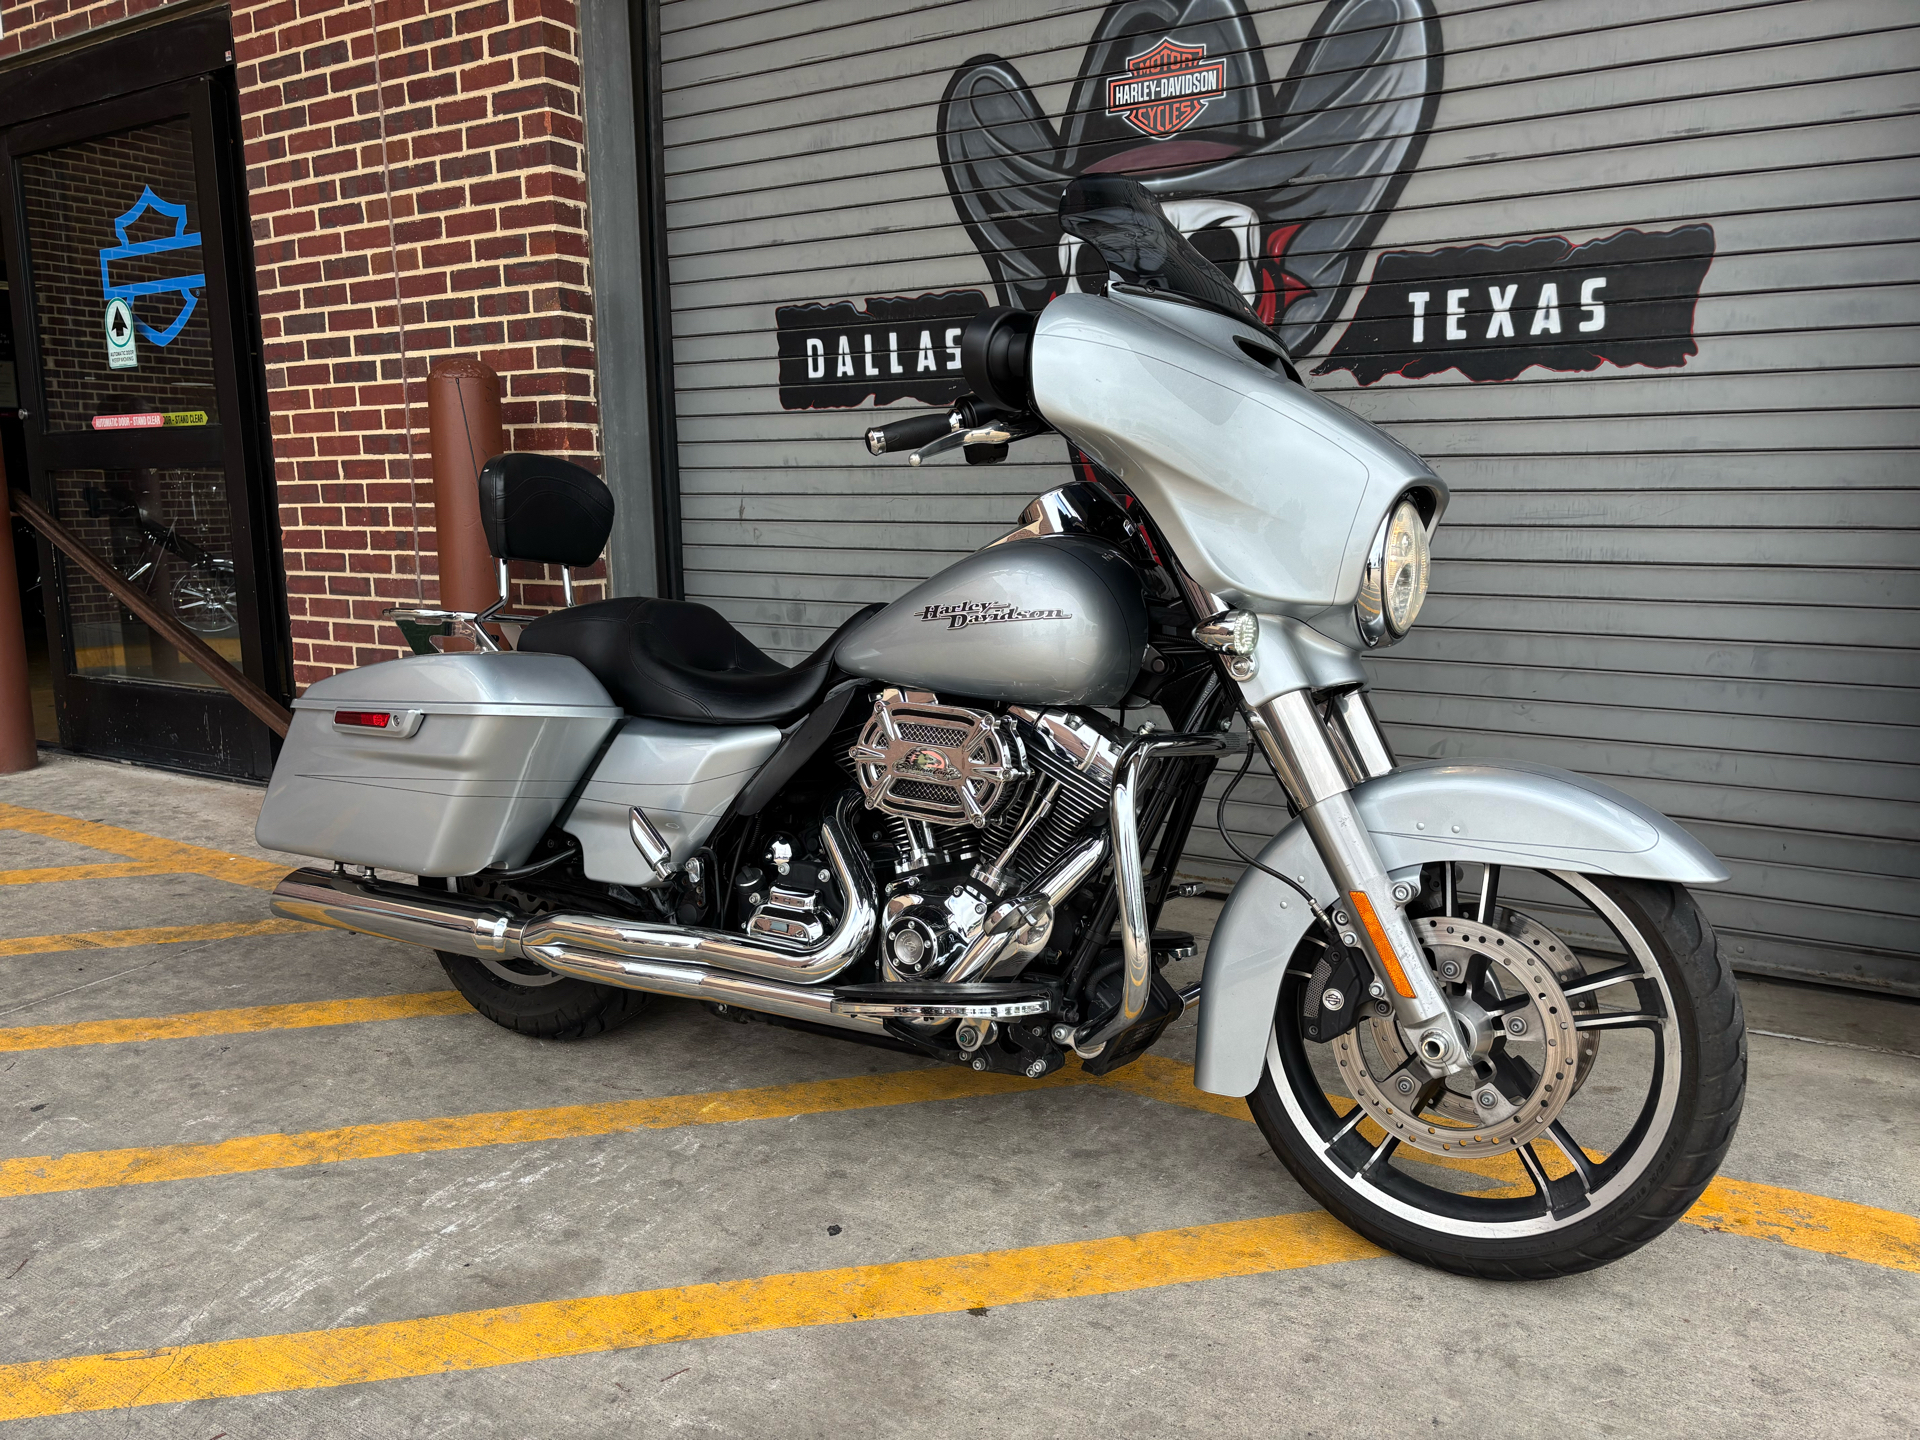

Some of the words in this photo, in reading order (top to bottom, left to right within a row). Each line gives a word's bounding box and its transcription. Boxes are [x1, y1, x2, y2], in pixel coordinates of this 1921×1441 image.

[1139, 49, 1193, 76] MOTOR
[1115, 70, 1217, 105] HARLEY-DAVIDSON
[1138, 102, 1191, 131] CYCLES
[1408, 277, 1607, 343] TEXAS
[806, 328, 962, 378] DALLAS
[96, 418, 118, 427] AUTOMATIC
[119, 417, 130, 426] DOOR
[133, 416, 147, 426] STAND
[147, 415, 161, 425] CLEAR
[175, 415, 189, 424] STAND
[190, 414, 204, 423] CLEAR
[917, 600, 1004, 621] Harley
[947, 606, 1072, 630] Davidson
